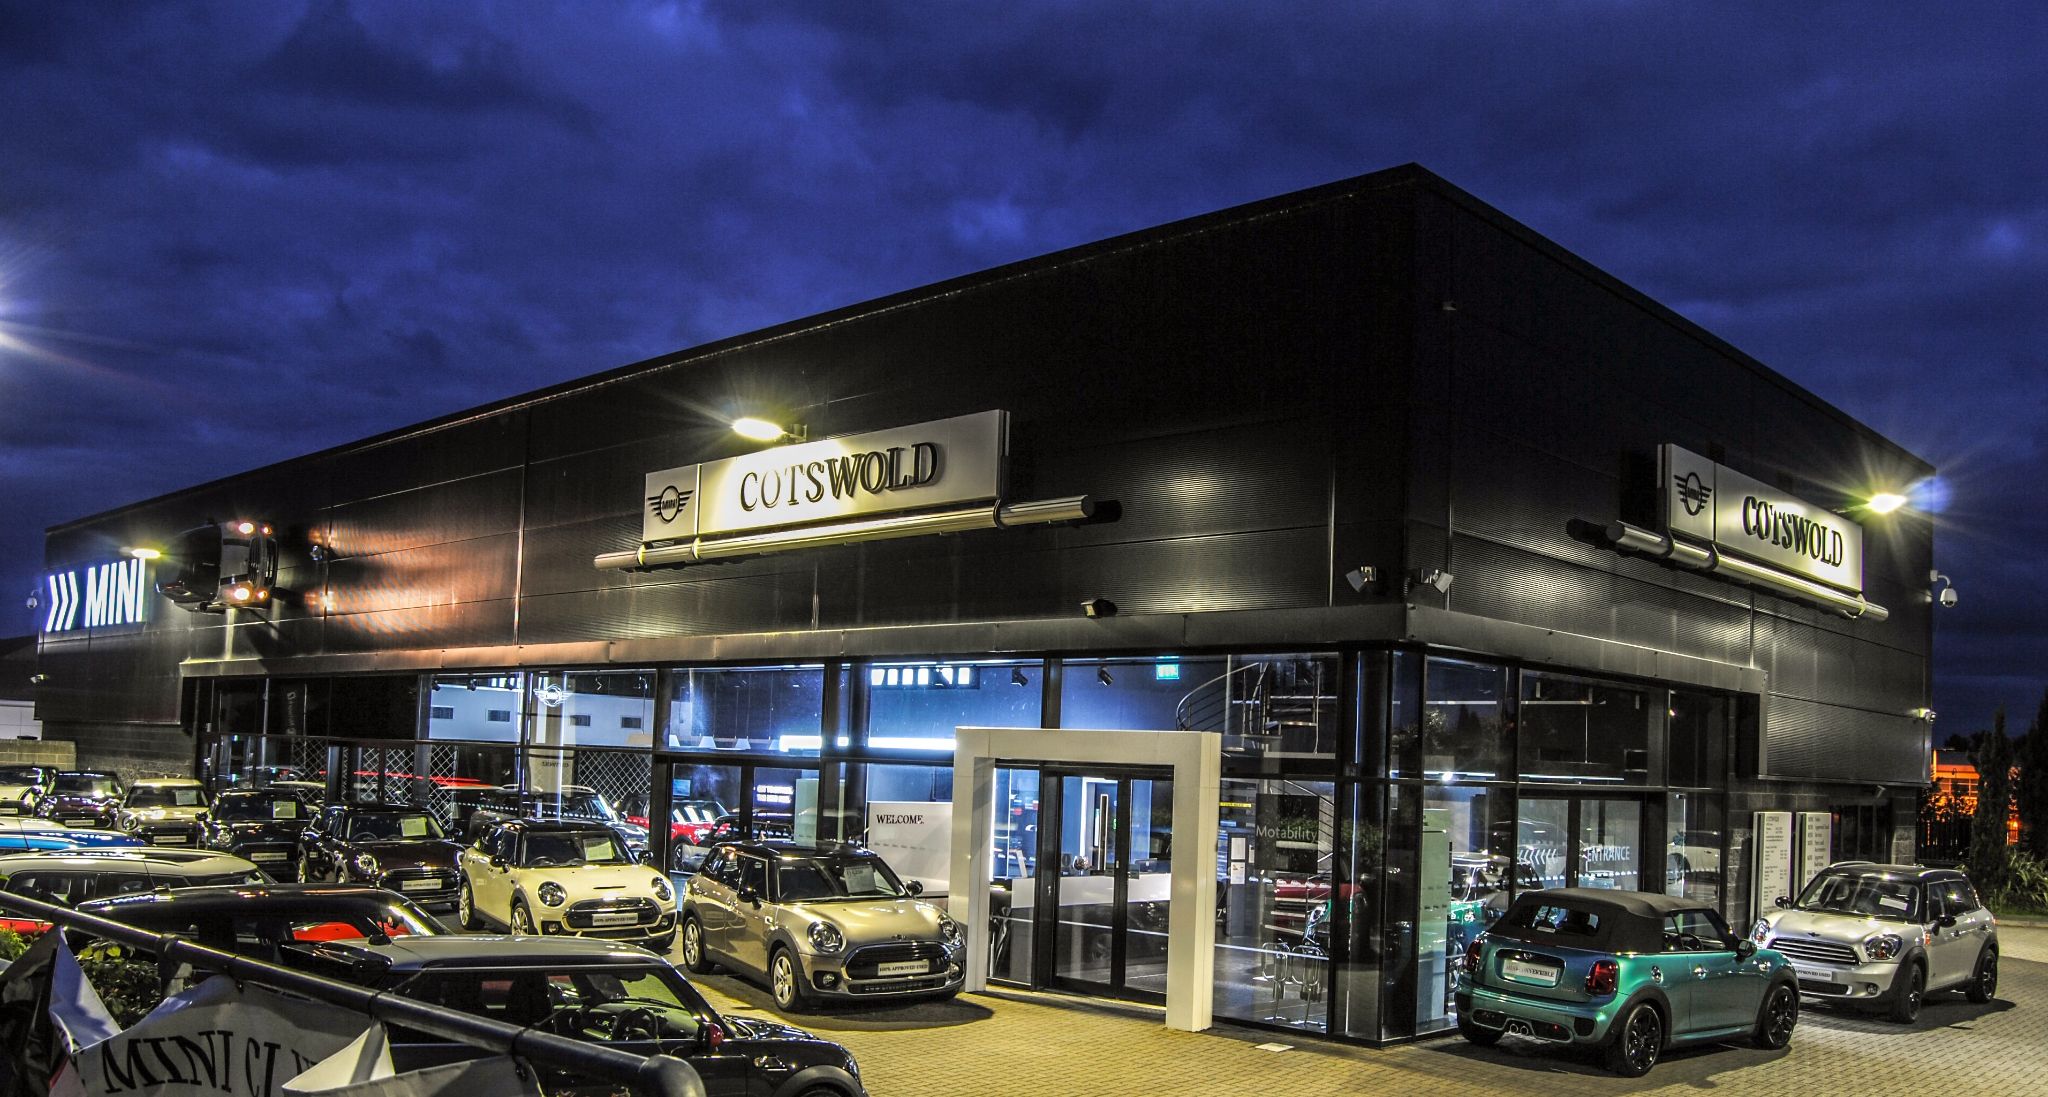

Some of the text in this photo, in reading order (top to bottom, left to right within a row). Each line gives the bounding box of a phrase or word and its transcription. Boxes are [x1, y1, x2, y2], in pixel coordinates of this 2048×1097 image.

[740, 442, 943, 511] COTSWOLD
[1742, 495, 1844, 568] COTSWOLD
[84, 557, 145, 627] MINI
[1256, 825, 1318, 843] Motability
[1587, 845, 1630, 862] ENTRANCE
[101, 1030, 234, 1094] MINI
